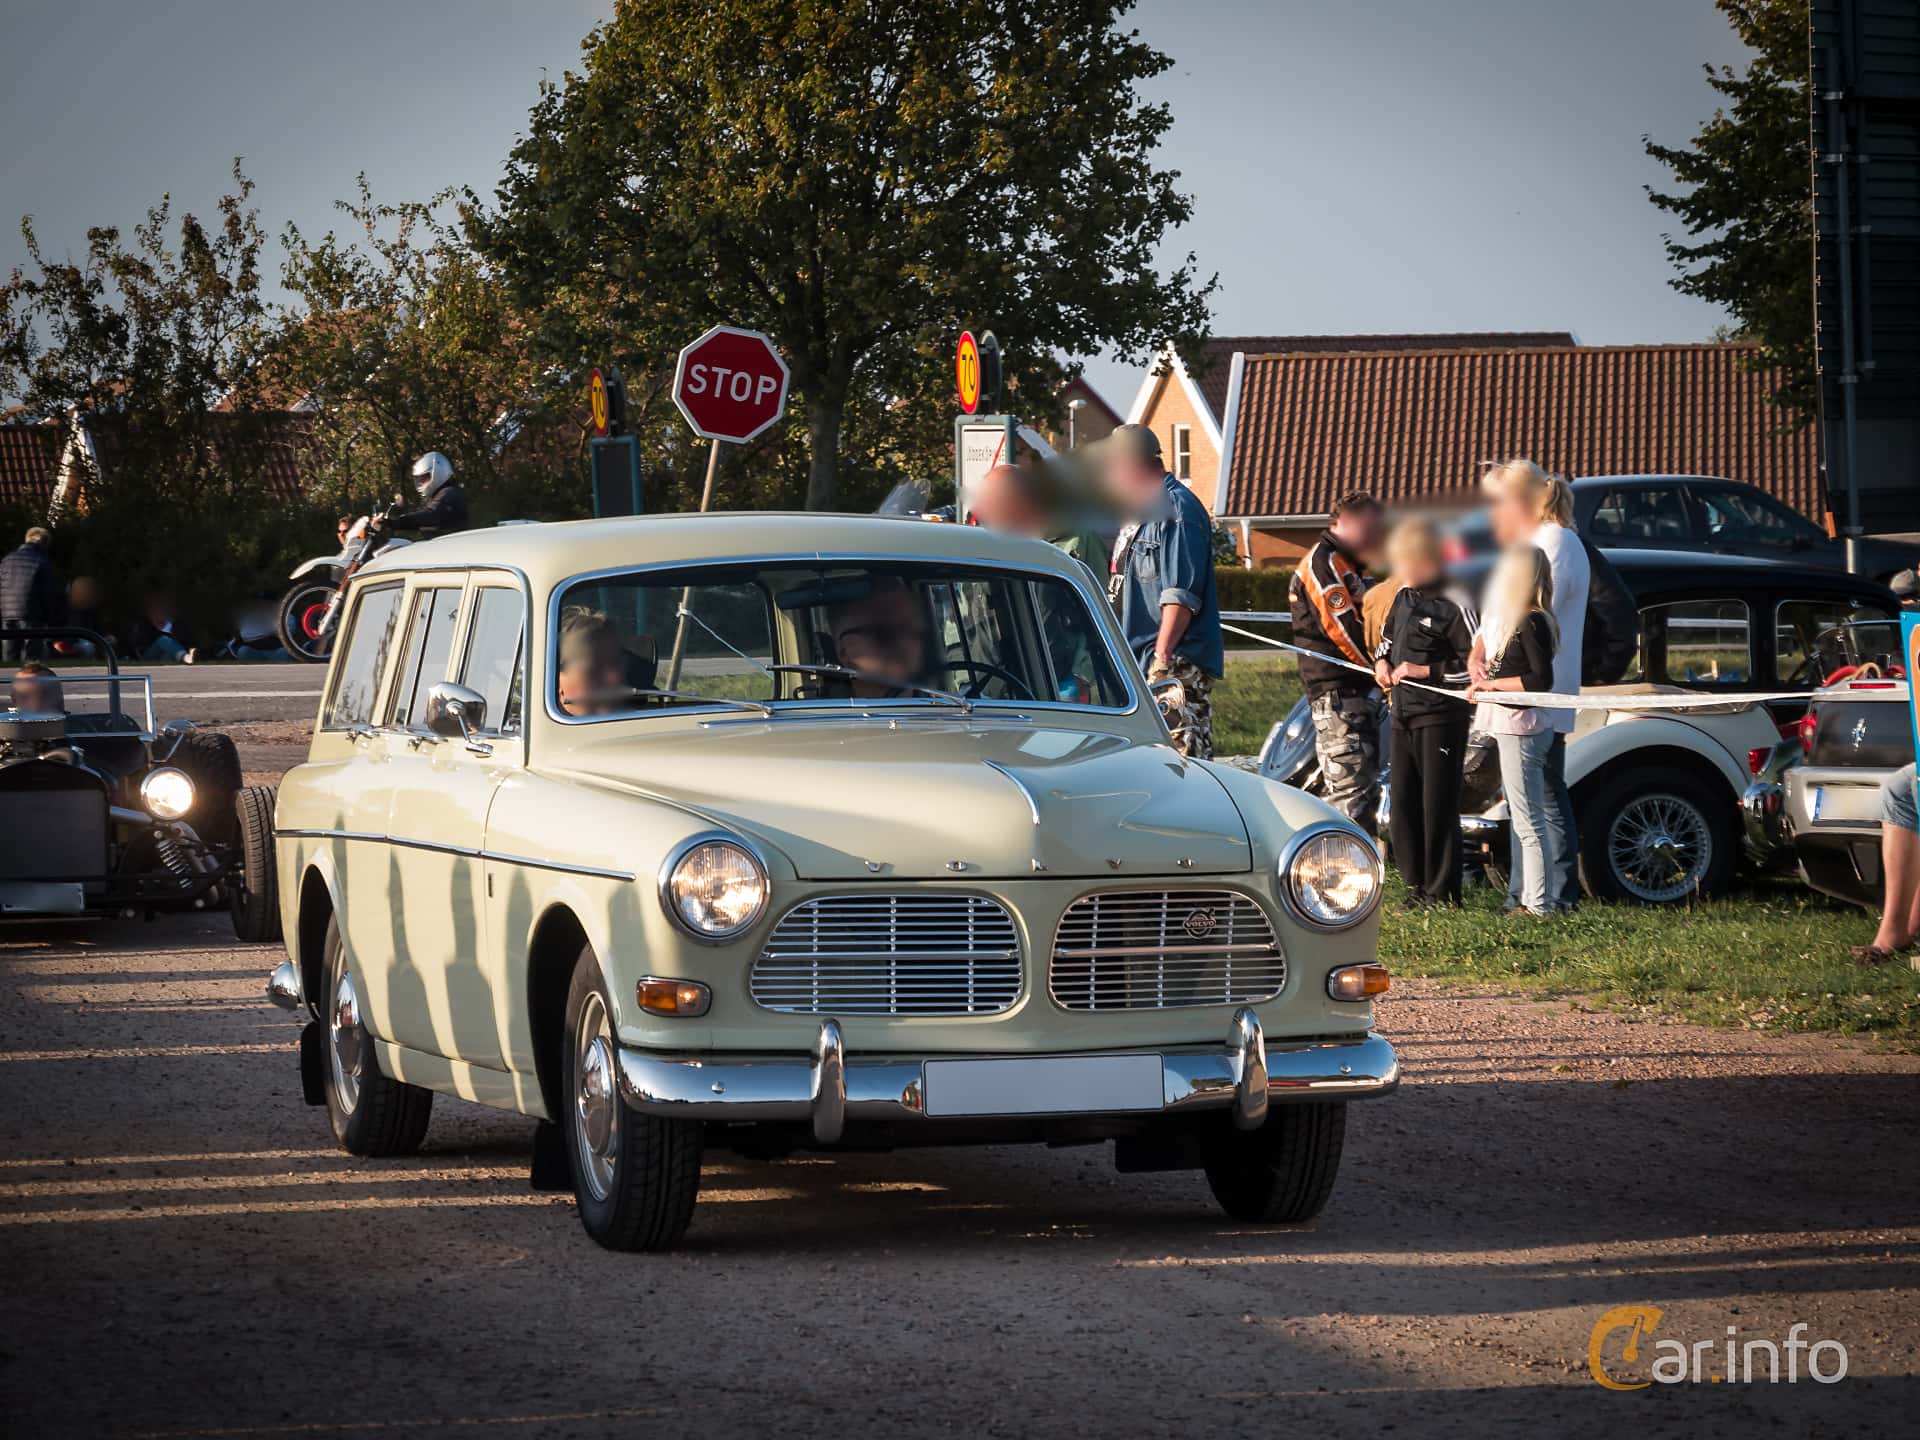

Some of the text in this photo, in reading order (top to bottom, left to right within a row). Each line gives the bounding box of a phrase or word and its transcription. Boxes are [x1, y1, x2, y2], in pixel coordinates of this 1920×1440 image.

[688, 364, 777, 405] STOP
[962, 354, 975, 393] 70
[1184, 920, 1216, 928] VOLVO
